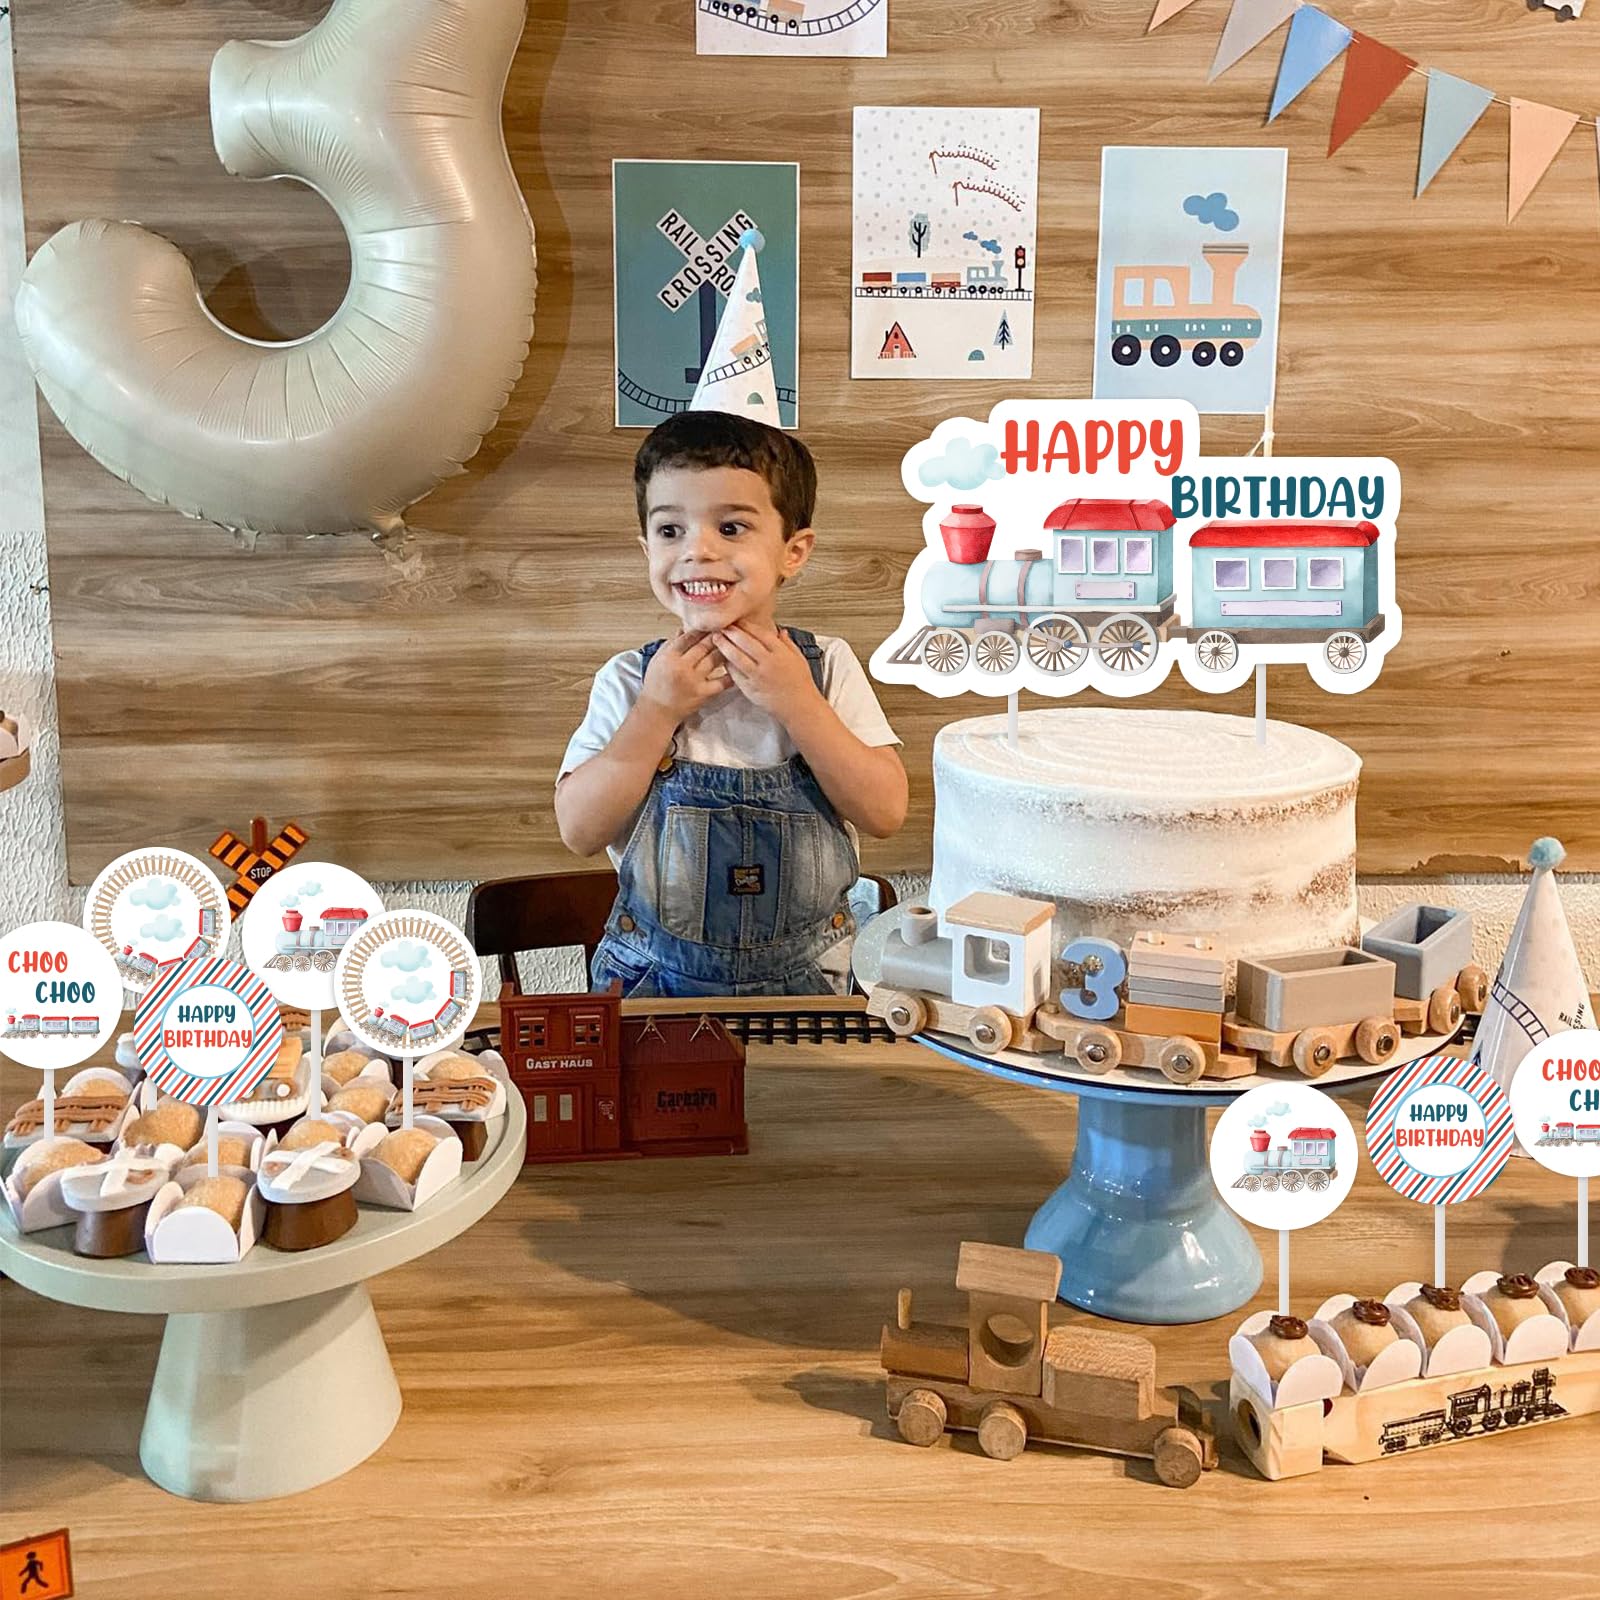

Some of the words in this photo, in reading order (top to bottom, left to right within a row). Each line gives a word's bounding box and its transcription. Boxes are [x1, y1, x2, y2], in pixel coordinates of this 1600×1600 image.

[660, 212, 698, 256] RAIL
[710, 264, 736, 297] RO
[660, 213, 754, 309] CROSSING
[1001, 419, 1184, 476] HAPPY
[1172, 475, 1385, 519] BIRTHDAY
[250, 866, 272, 879] STOP
[8, 950, 68, 974] CHOO
[1060, 936, 1127, 1020] 3
[35, 981, 96, 1004] CHOO
[178, 1005, 236, 1024] HAPPY
[164, 1029, 252, 1049] BIRTHDAY
[526, 1058, 557, 1070] GAST
[560, 1059, 593, 1069] HAUS
[1542, 1058, 1600, 1081] CHOO
[1569, 1089, 1600, 1112] CH
[1409, 1104, 1468, 1123] HAPPY
[1396, 1128, 1485, 1147] BIRTHDAY
